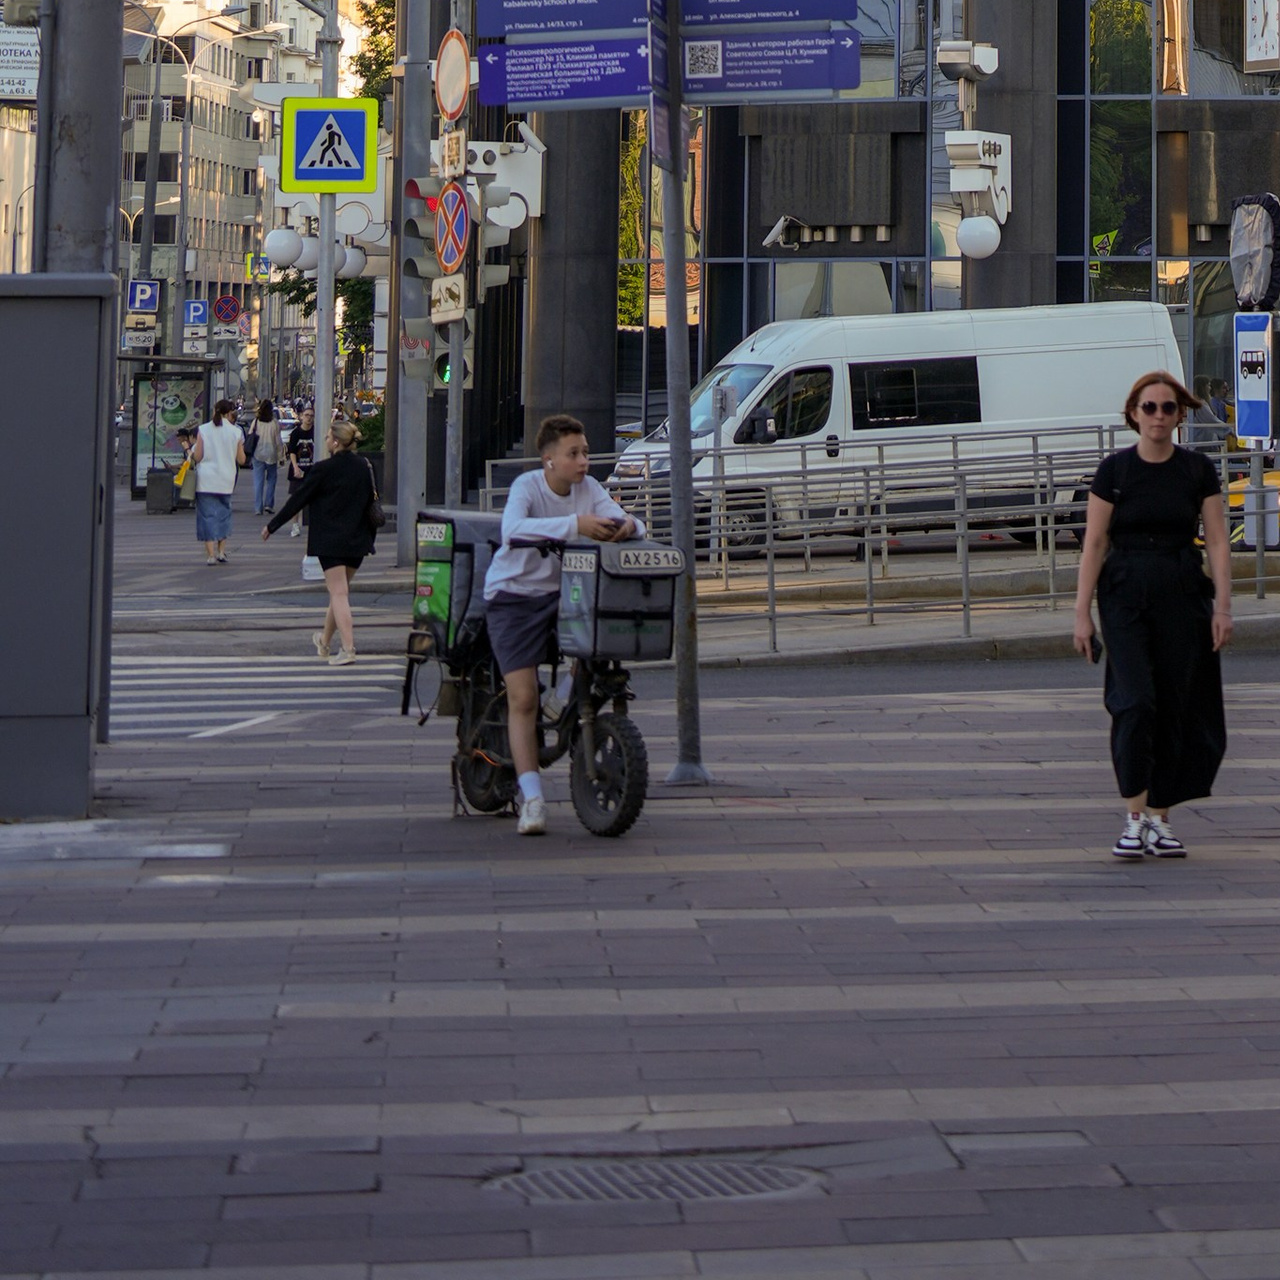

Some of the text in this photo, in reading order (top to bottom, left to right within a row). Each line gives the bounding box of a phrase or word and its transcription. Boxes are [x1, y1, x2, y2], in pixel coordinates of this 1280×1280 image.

[503, 0, 542, 8] Kabalevsky
[815, 37, 836, 46] Герой
[726, 49, 763, 57] Советского
[763, 48, 785, 57] Союза
[506, 56, 545, 66] диспансер
[566, 52, 598, 61] Клиника
[506, 64, 534, 72] Филиал
[507, 71, 553, 80] клиническая
[554, 68, 589, 78] больница
[135, 284, 152, 308] P
[189, 303, 204, 323] P
